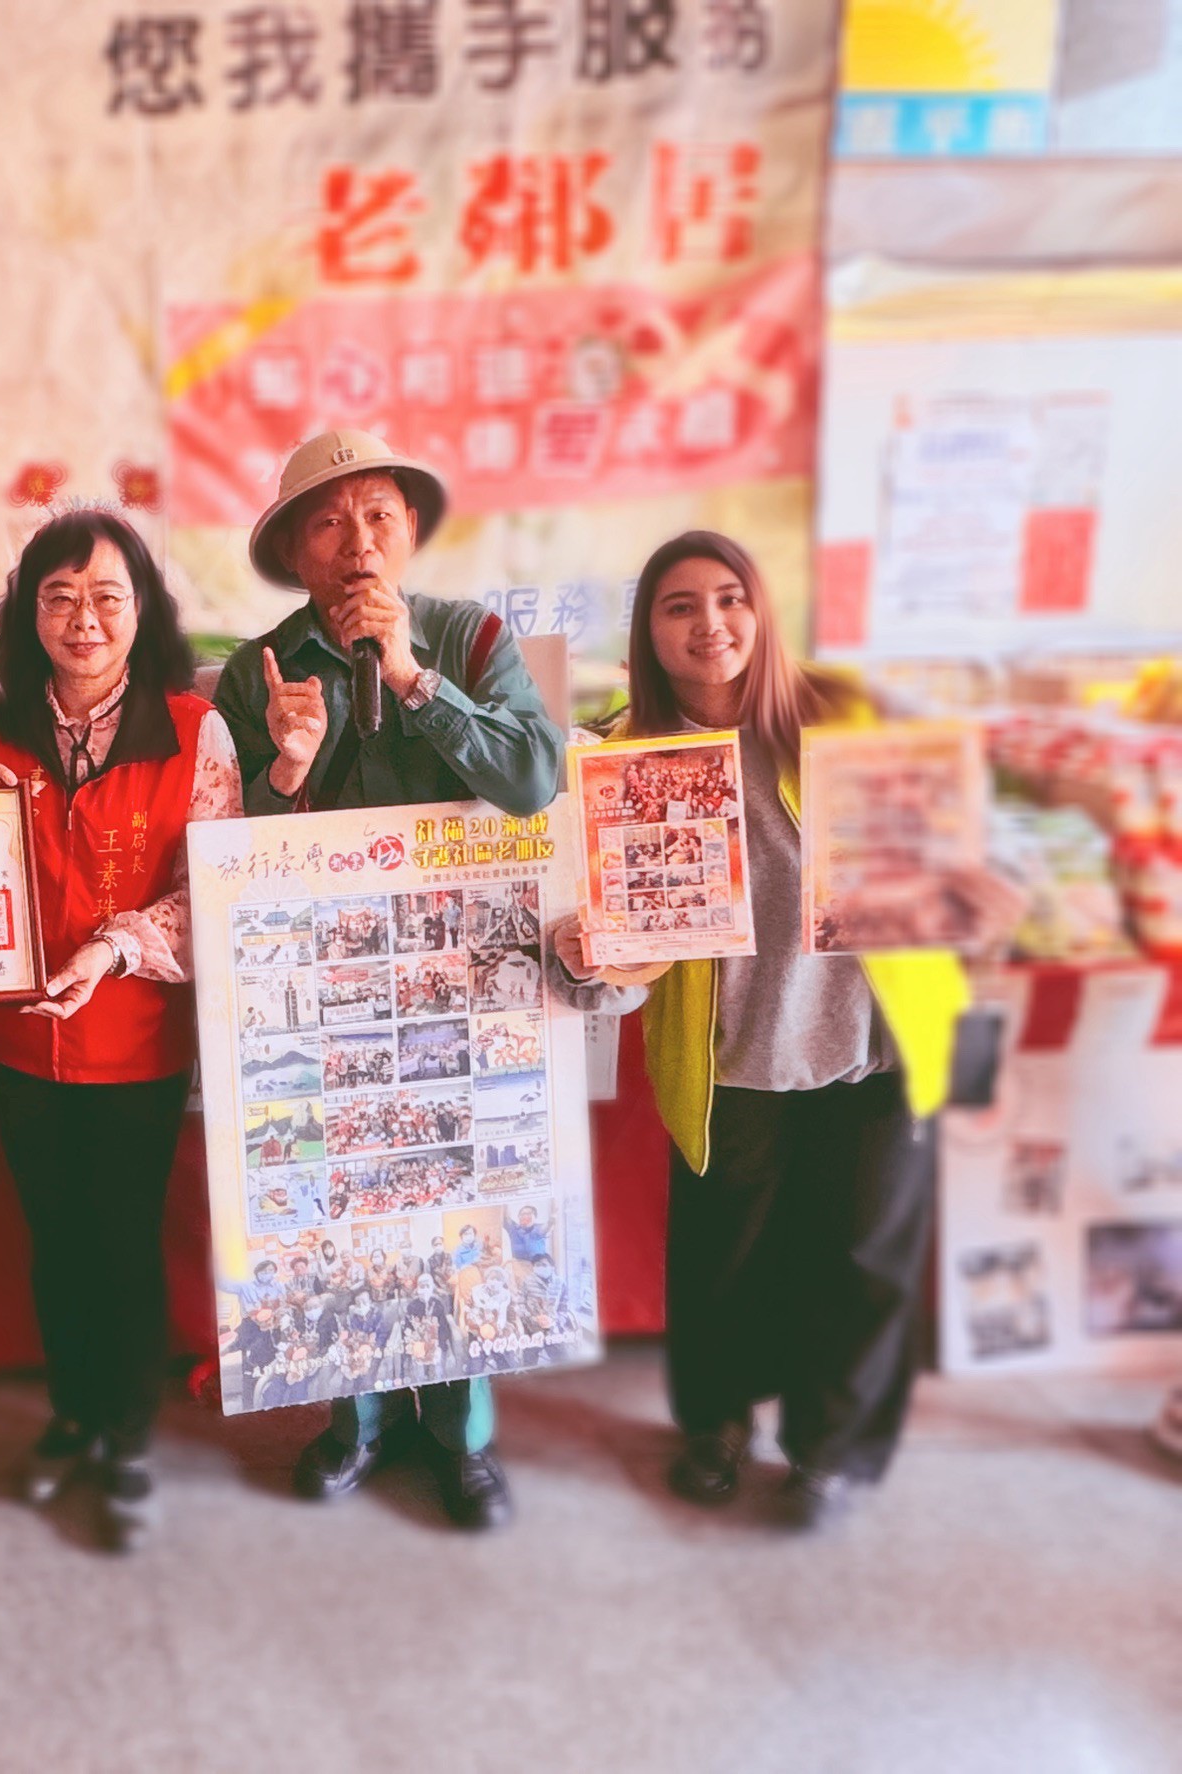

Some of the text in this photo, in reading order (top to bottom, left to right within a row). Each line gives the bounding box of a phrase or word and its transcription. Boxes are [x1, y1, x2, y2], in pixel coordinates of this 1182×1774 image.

[318, 143, 760, 284] 老鄰居
[131, 811, 147, 875] 副局長
[217, 840, 325, 882] 旅行臺灣
[409, 838, 556, 869] 守護社區老朋友
[92, 829, 123, 922] 王素珠
